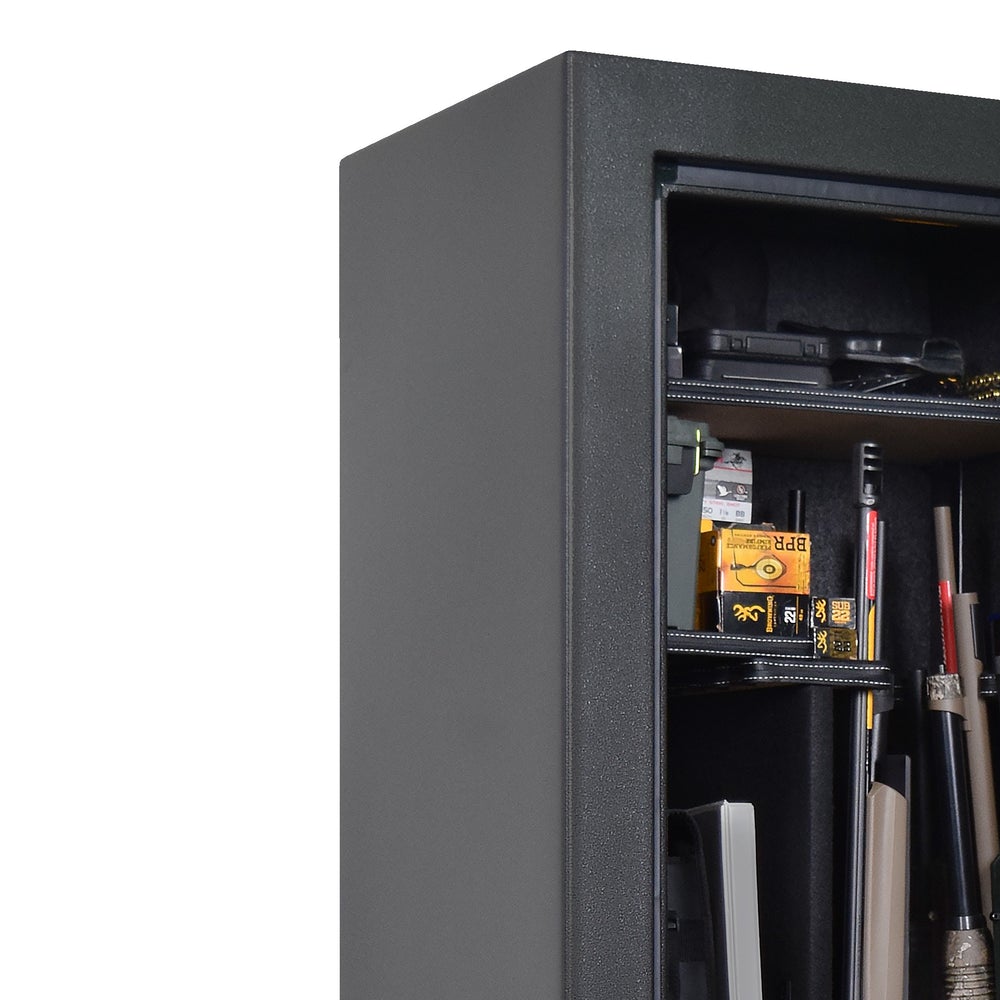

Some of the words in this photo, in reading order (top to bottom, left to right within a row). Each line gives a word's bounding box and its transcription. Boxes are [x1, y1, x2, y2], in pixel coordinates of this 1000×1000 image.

[774, 536, 807, 552] BPR
[831, 600, 851, 610] SUB
[831, 610, 851, 621] 22
